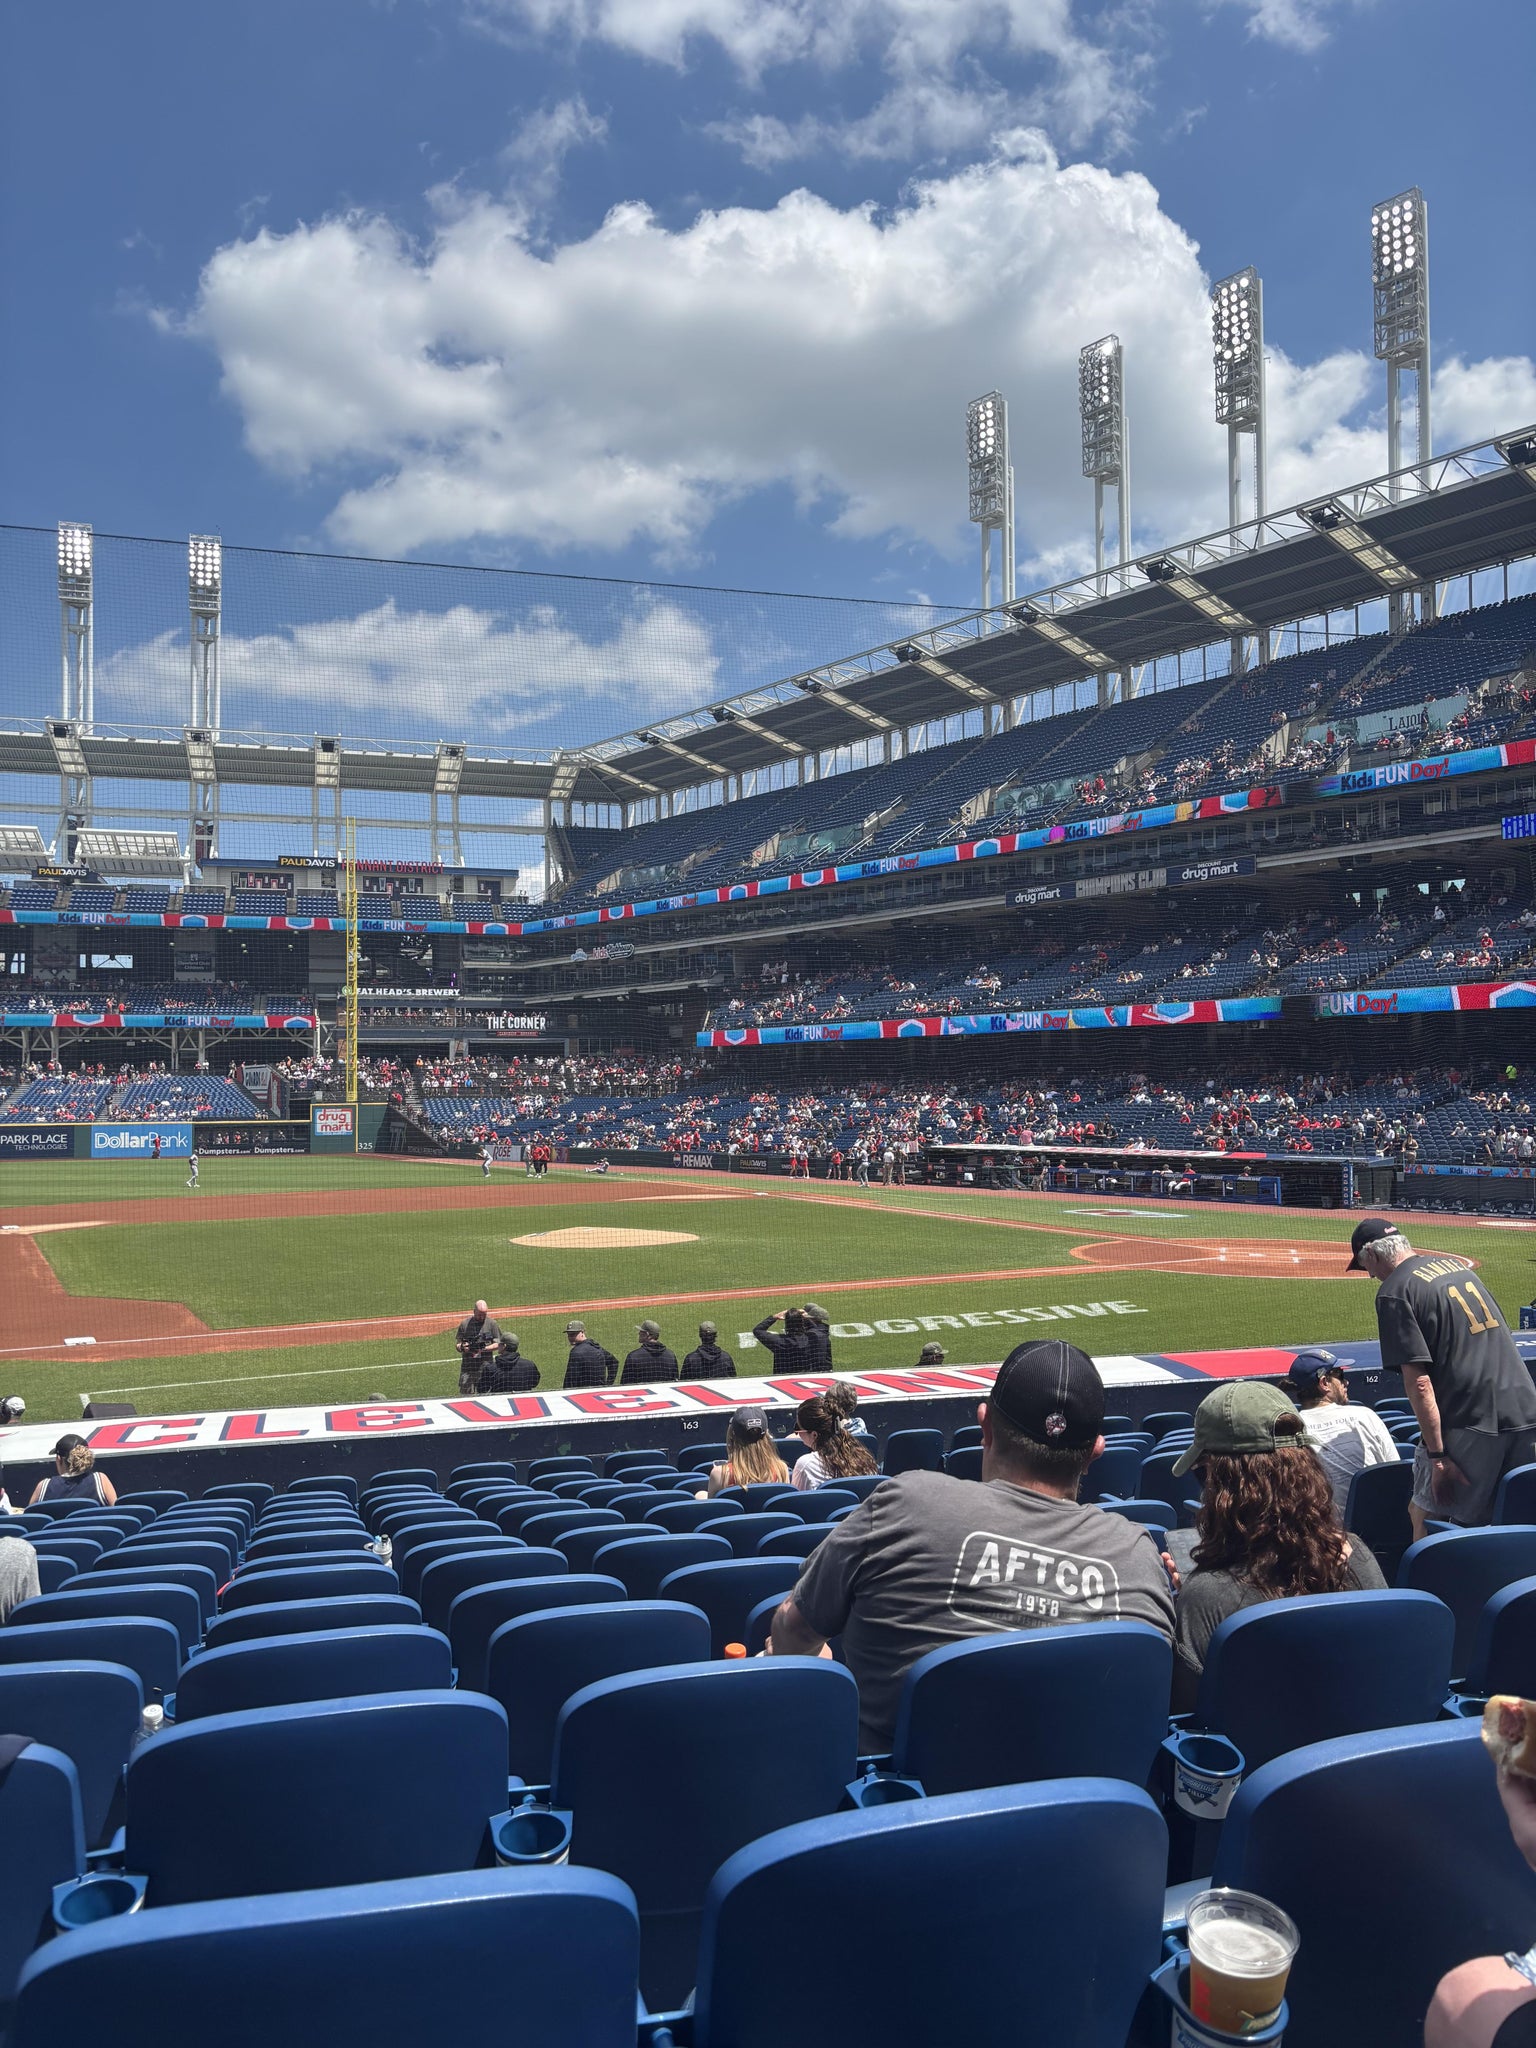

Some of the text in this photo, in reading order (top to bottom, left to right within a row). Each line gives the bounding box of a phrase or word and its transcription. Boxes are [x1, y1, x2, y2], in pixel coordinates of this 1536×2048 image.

[1388, 713, 1422, 731] LAJOI
[1341, 758, 1449, 791] Kids FUN Day!
[1064, 825, 1087, 839] Kids
[396, 860, 445, 874] DISTRICT
[862, 854, 919, 876] Kids FUN Day!
[1182, 861, 1238, 881] drug mart
[1015, 887, 1061, 904] drug mart
[656, 900, 670, 911] Kids
[670, 898, 683, 910] FUN
[58, 912, 131, 925] Kids FUN Day!
[362, 920, 428, 932] Kids FUN Day!
[376, 988, 412, 996] HEAD'S
[416, 988, 460, 996] BREWERY
[1319, 993, 1398, 1015] FUN Day!
[164, 1016, 235, 1028] Kids FUN Day!
[487, 1016, 546, 1030] THE CORNER
[785, 1025, 843, 1041] Kids FUN Day!
[318, 1108, 347, 1124] drug
[320, 1122, 352, 1132] mart
[1, 1134, 68, 1144] PARK PLACE
[358, 1142, 373, 1150] 325
[15, 1143, 68, 1151] TECHNOLOGIES
[493, 1146, 512, 1160] ROSE
[1448, 1281, 1500, 1335] 11
[736, 1299, 1149, 1350] POGRESSIVE
[682, 1420, 699, 1430] 163
[969, 1541, 1106, 1610] AFTCO
[1015, 1592, 1060, 1618] 1958
